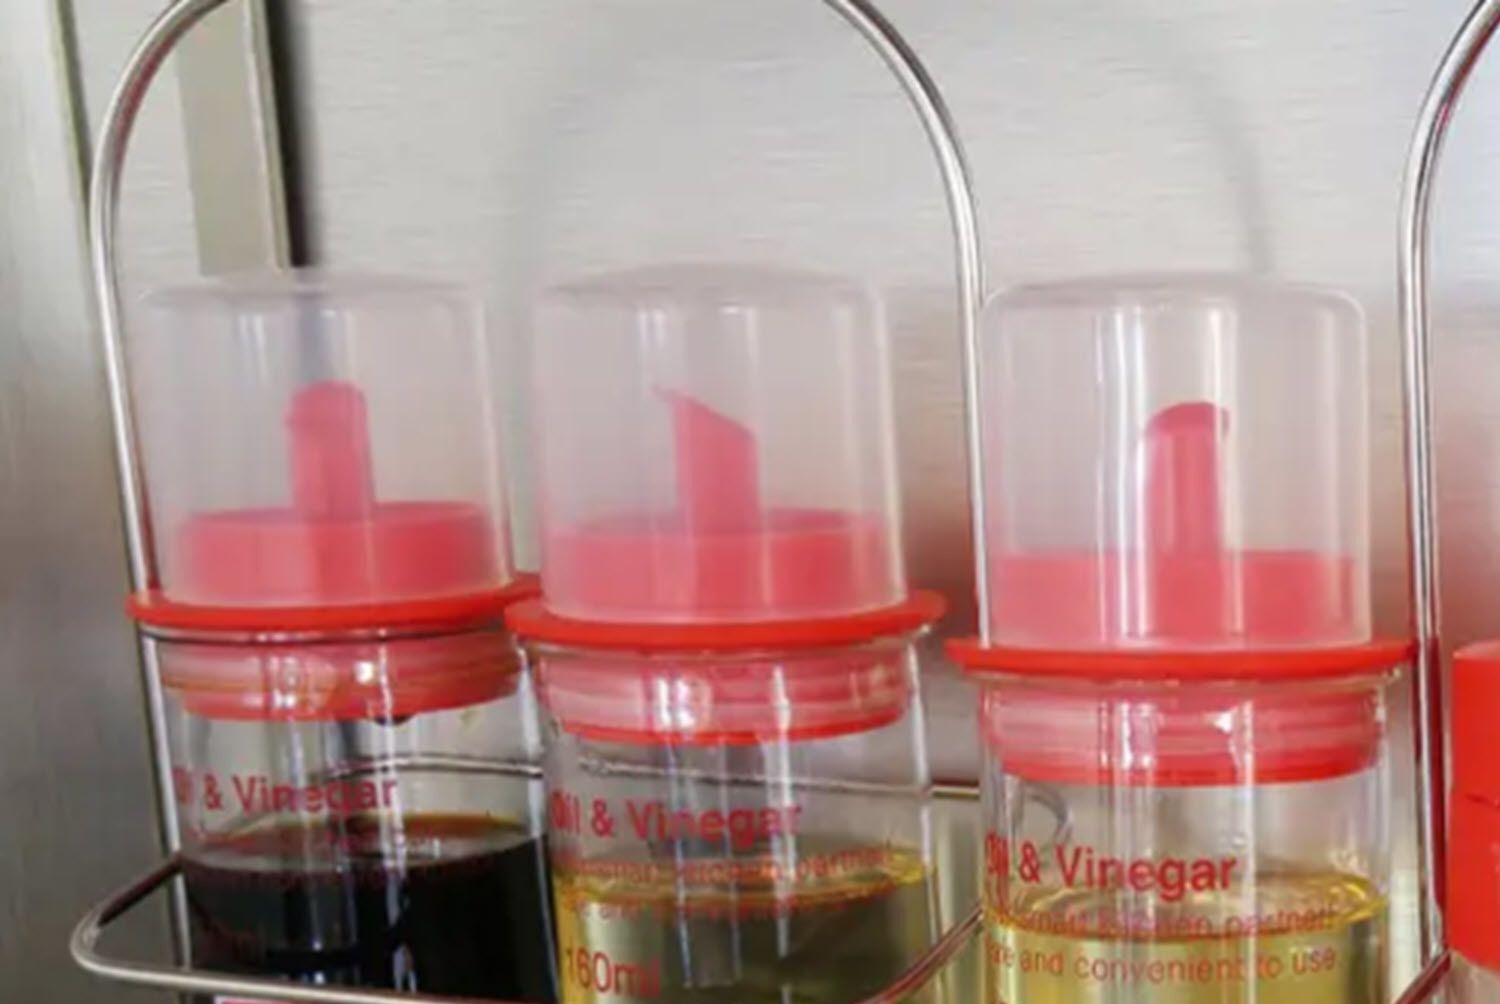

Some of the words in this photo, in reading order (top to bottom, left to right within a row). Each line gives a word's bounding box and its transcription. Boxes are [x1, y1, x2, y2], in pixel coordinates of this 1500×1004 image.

[232, 773, 398, 817] Vinegar
[591, 800, 615, 838] &
[628, 803, 802, 846] Vinegar
[1018, 841, 1040, 884] &
[1055, 844, 1237, 902] Vinegar
